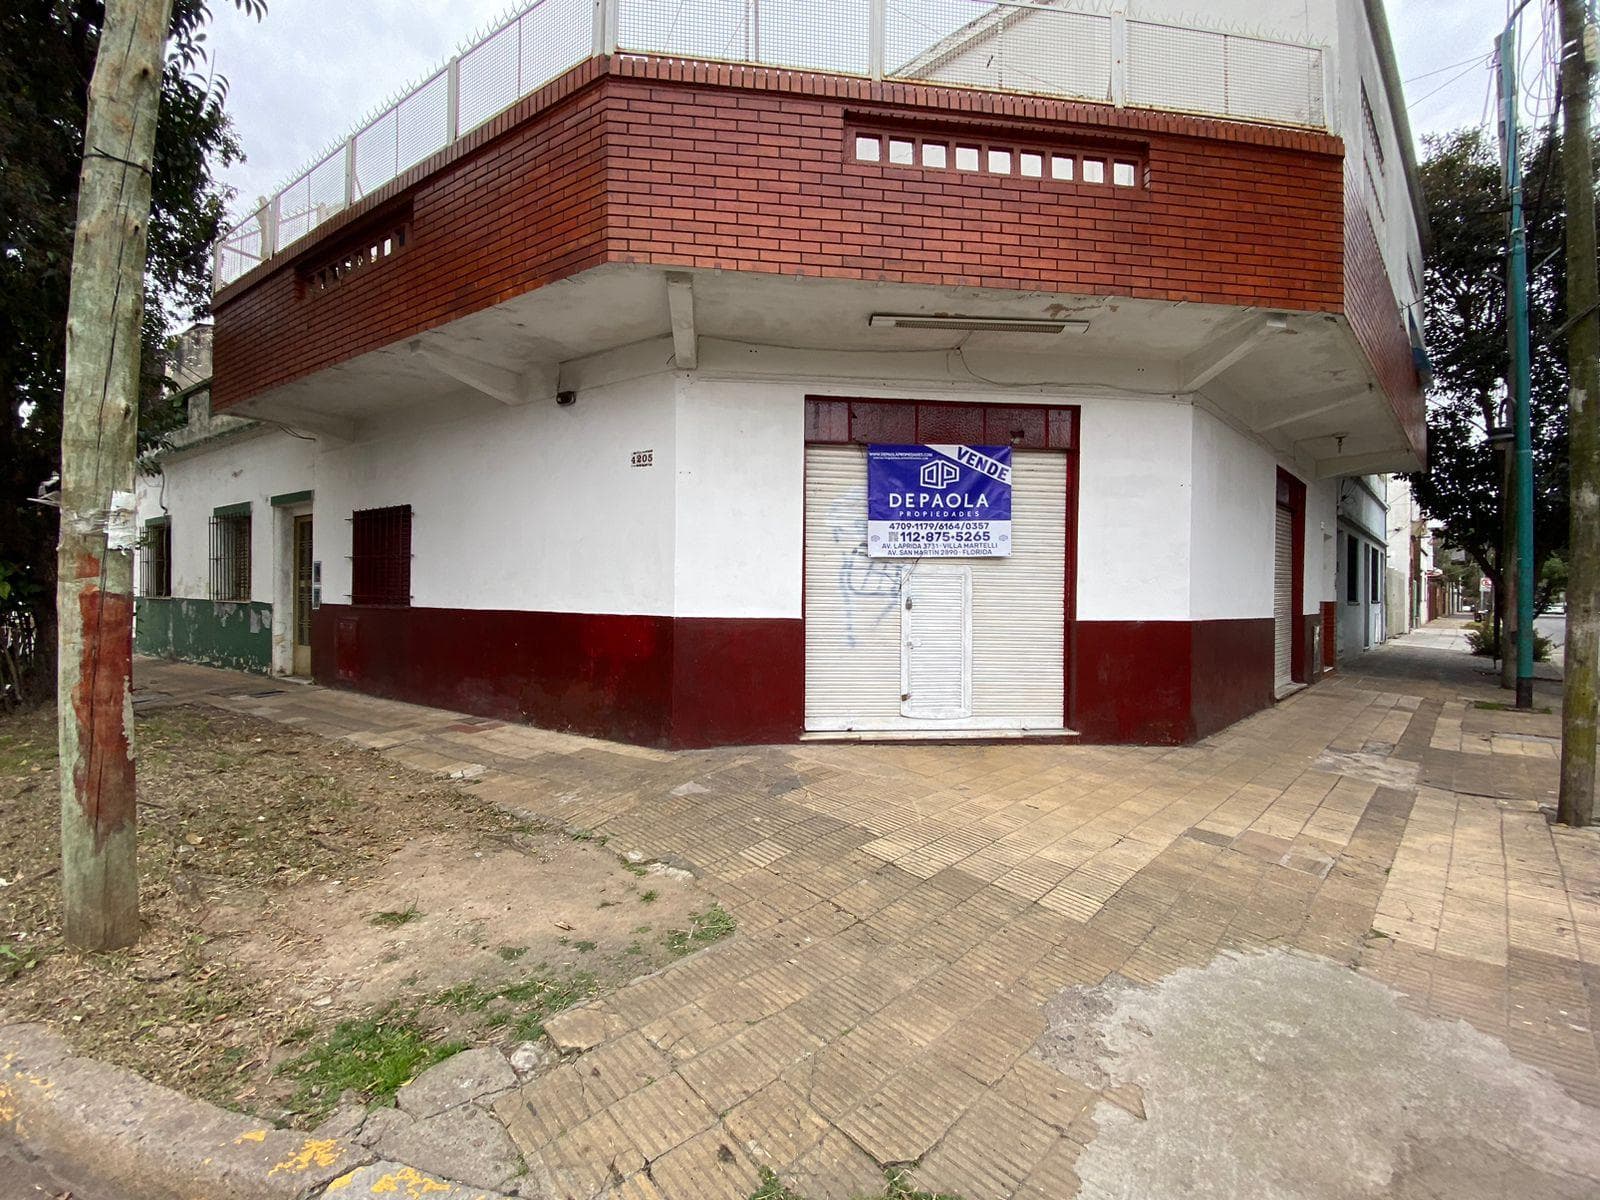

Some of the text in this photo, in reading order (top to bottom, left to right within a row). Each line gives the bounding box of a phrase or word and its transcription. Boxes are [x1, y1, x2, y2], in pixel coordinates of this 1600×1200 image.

[630, 454, 653, 464] 4205
[957, 446, 1009, 481] VENDE
[889, 493, 989, 508] DEPAOLA
